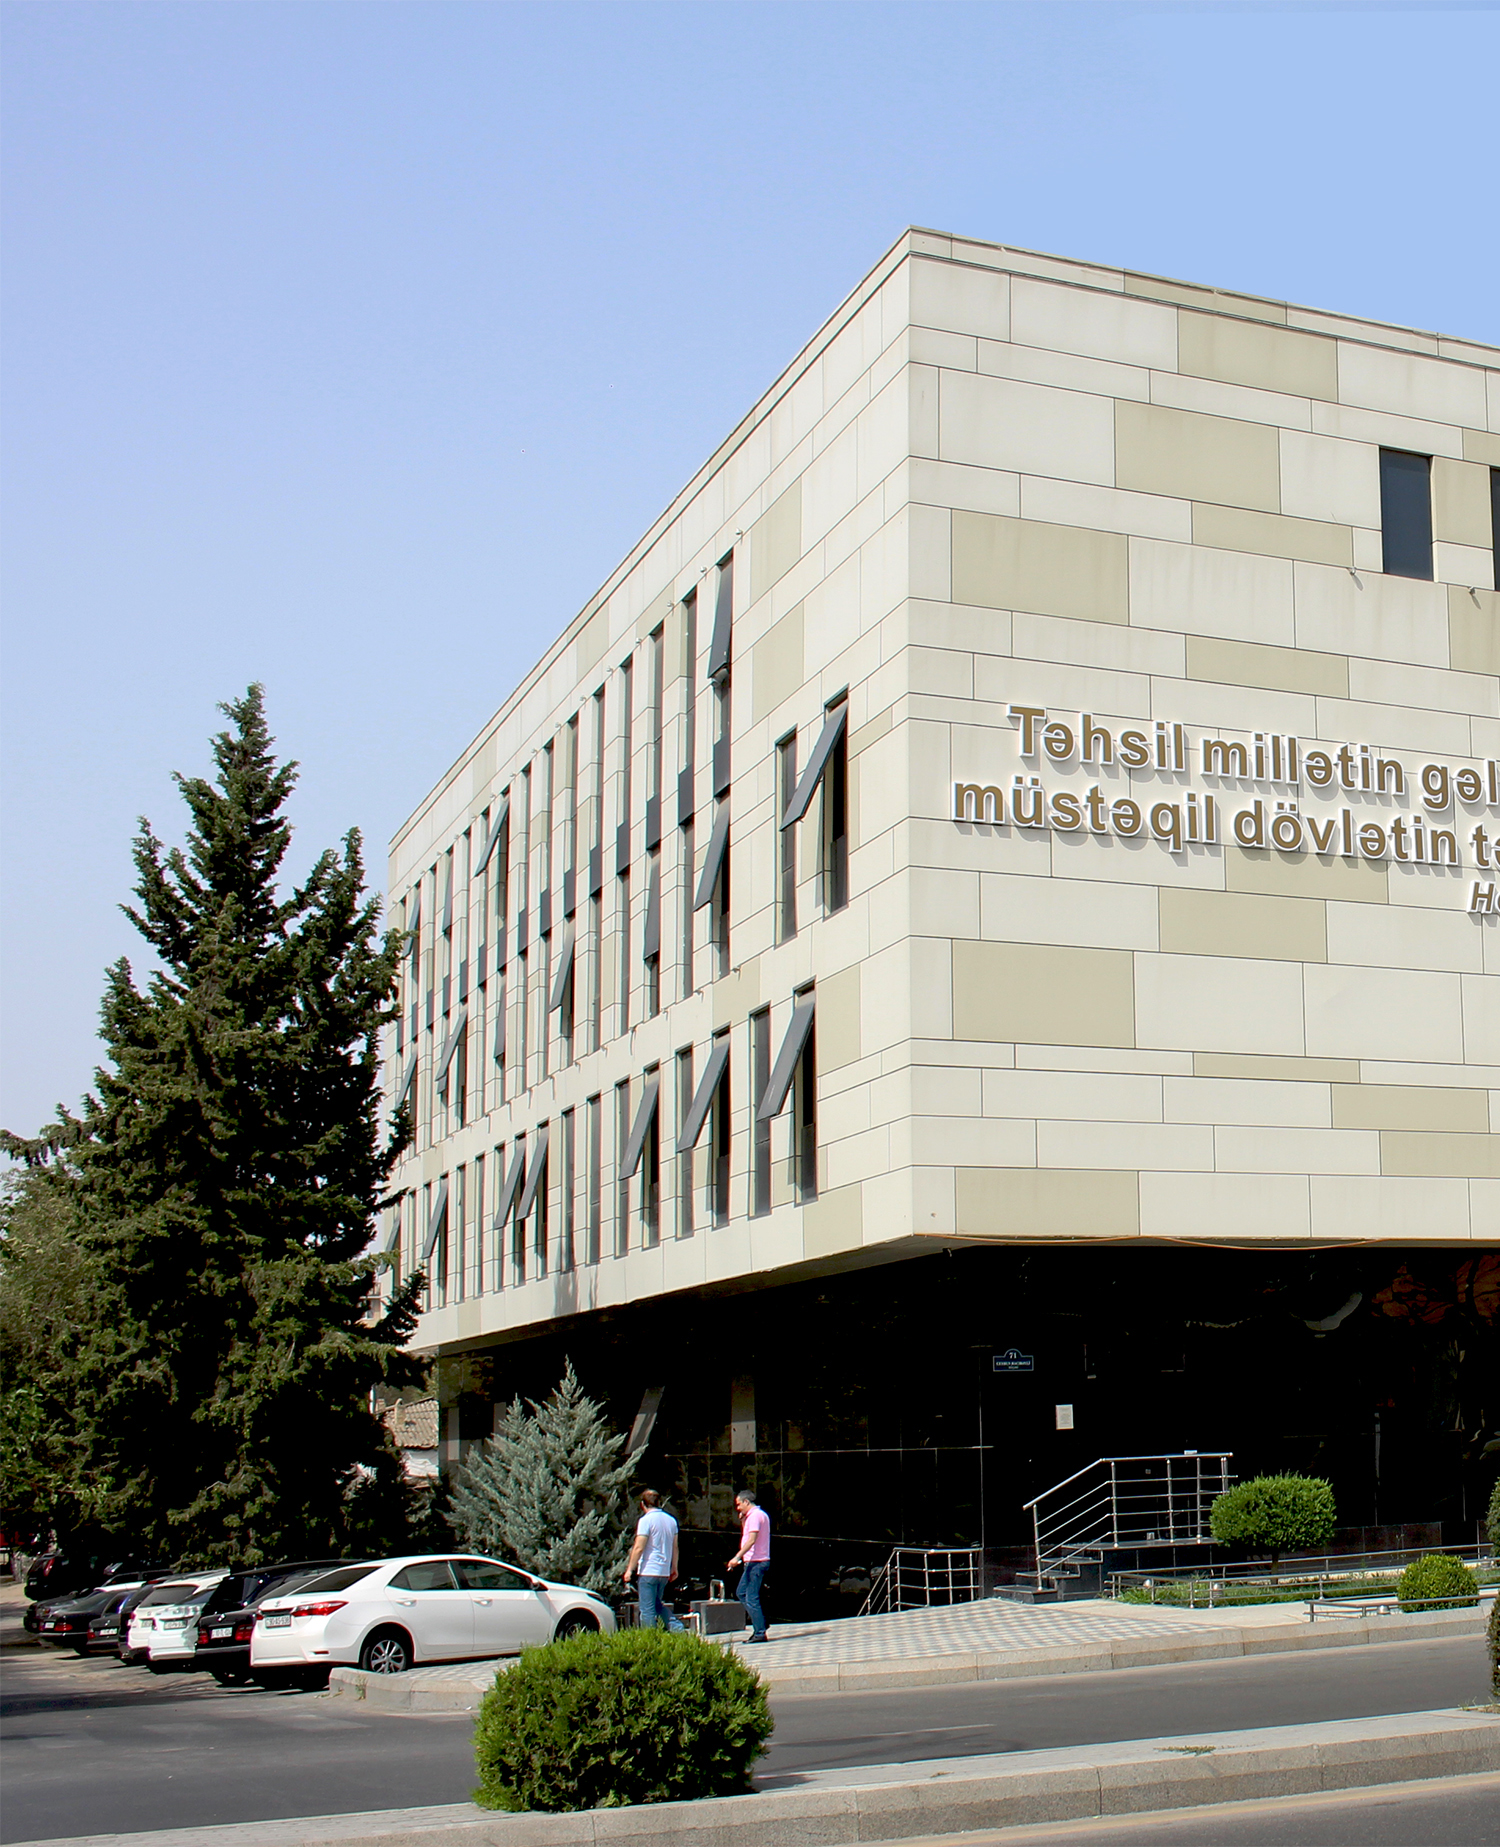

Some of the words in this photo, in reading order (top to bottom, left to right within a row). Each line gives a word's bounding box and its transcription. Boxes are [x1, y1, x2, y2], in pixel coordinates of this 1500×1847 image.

[1006, 704, 1187, 774] Təhsil
[1201, 731, 1405, 796] millətin
[952, 774, 1218, 854] müstəqil
[1232, 799, 1461, 868] dövlətin
